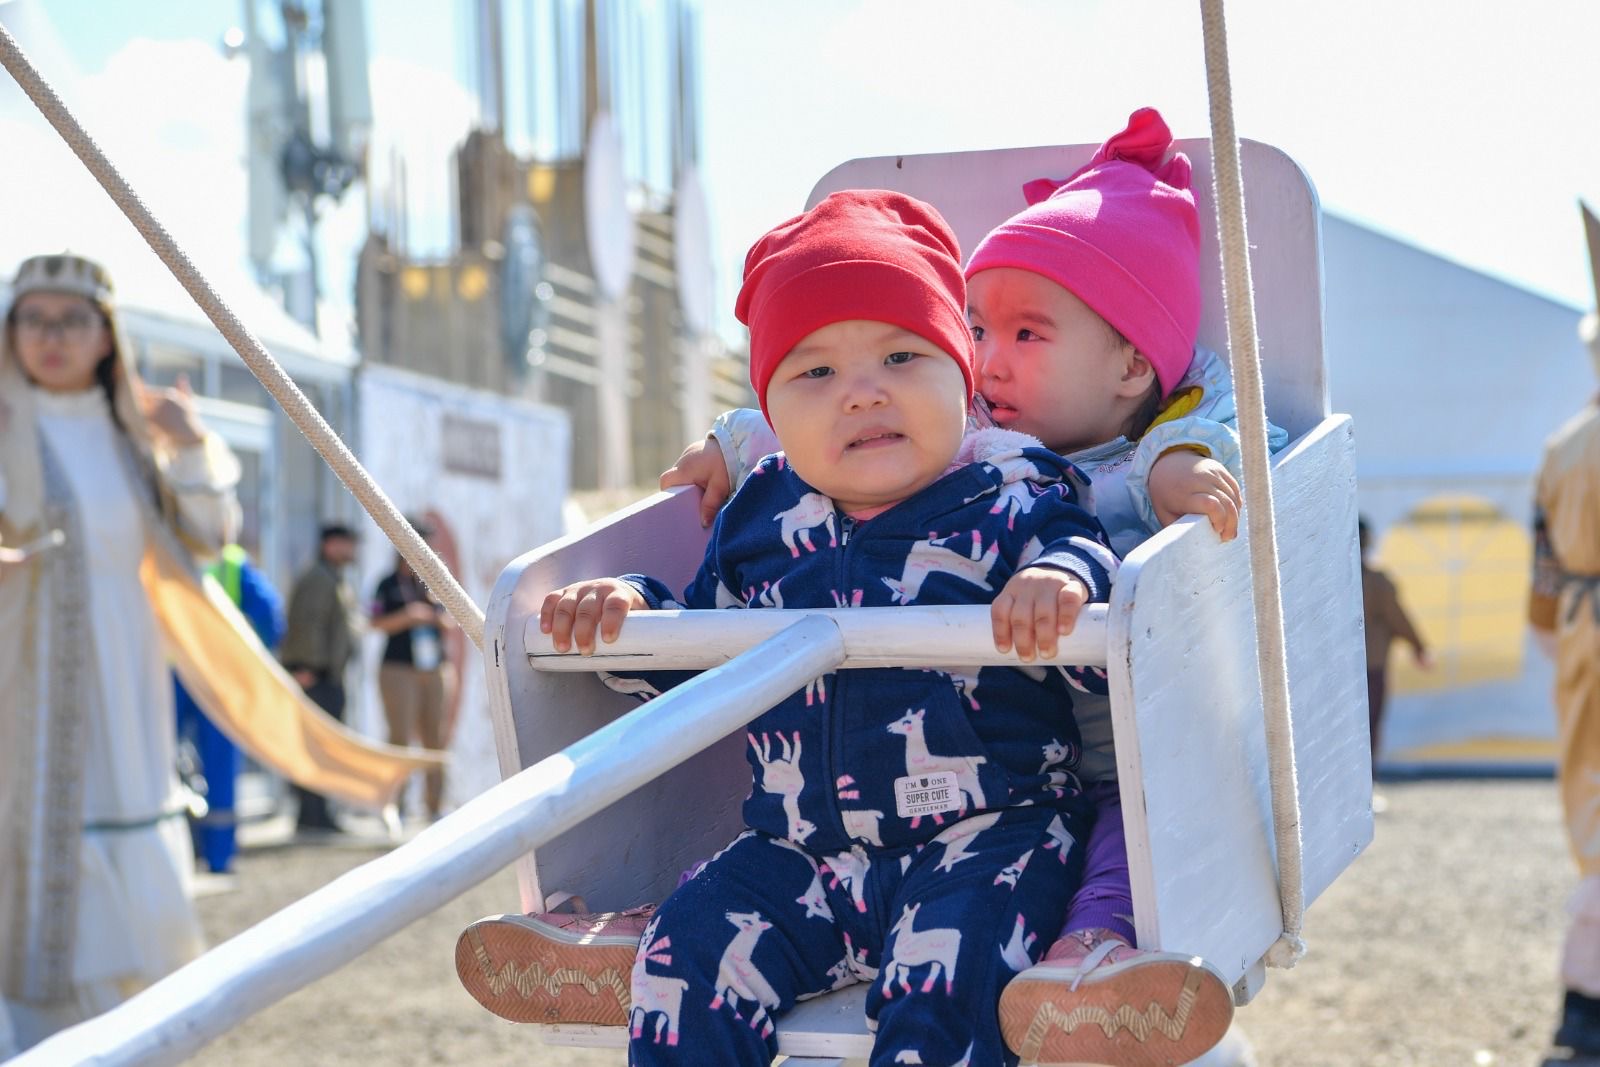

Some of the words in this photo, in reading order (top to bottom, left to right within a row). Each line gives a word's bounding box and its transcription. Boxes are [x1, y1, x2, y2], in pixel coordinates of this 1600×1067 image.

[905, 782, 917, 790] I'M
[931, 777, 947, 785] ONE
[906, 791, 930, 804] SUPER
[931, 788, 950, 801] CUTE
[909, 804, 948, 814] GENTLEMAN
